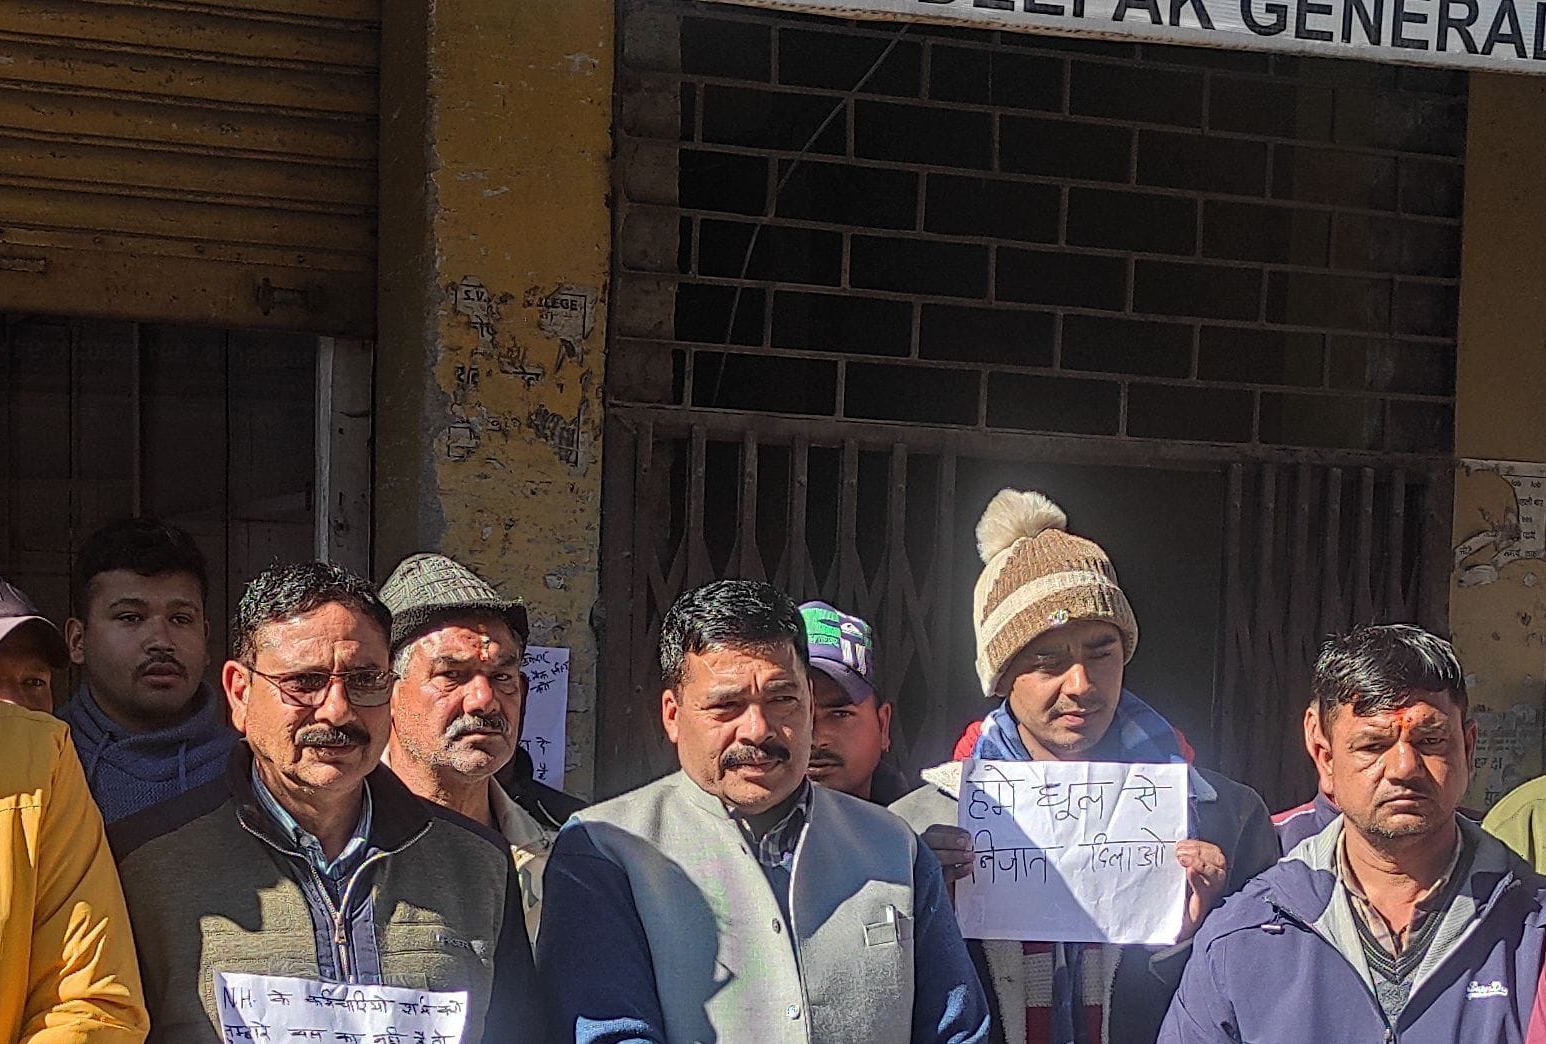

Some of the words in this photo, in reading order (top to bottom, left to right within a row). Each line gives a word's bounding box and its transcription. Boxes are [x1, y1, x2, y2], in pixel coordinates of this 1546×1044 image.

[1032, 781, 1114, 822] धूल
[1122, 774, 1173, 813] से
[1078, 827, 1178, 873] दिलाओ
[335, 1031, 366, 1044] का
